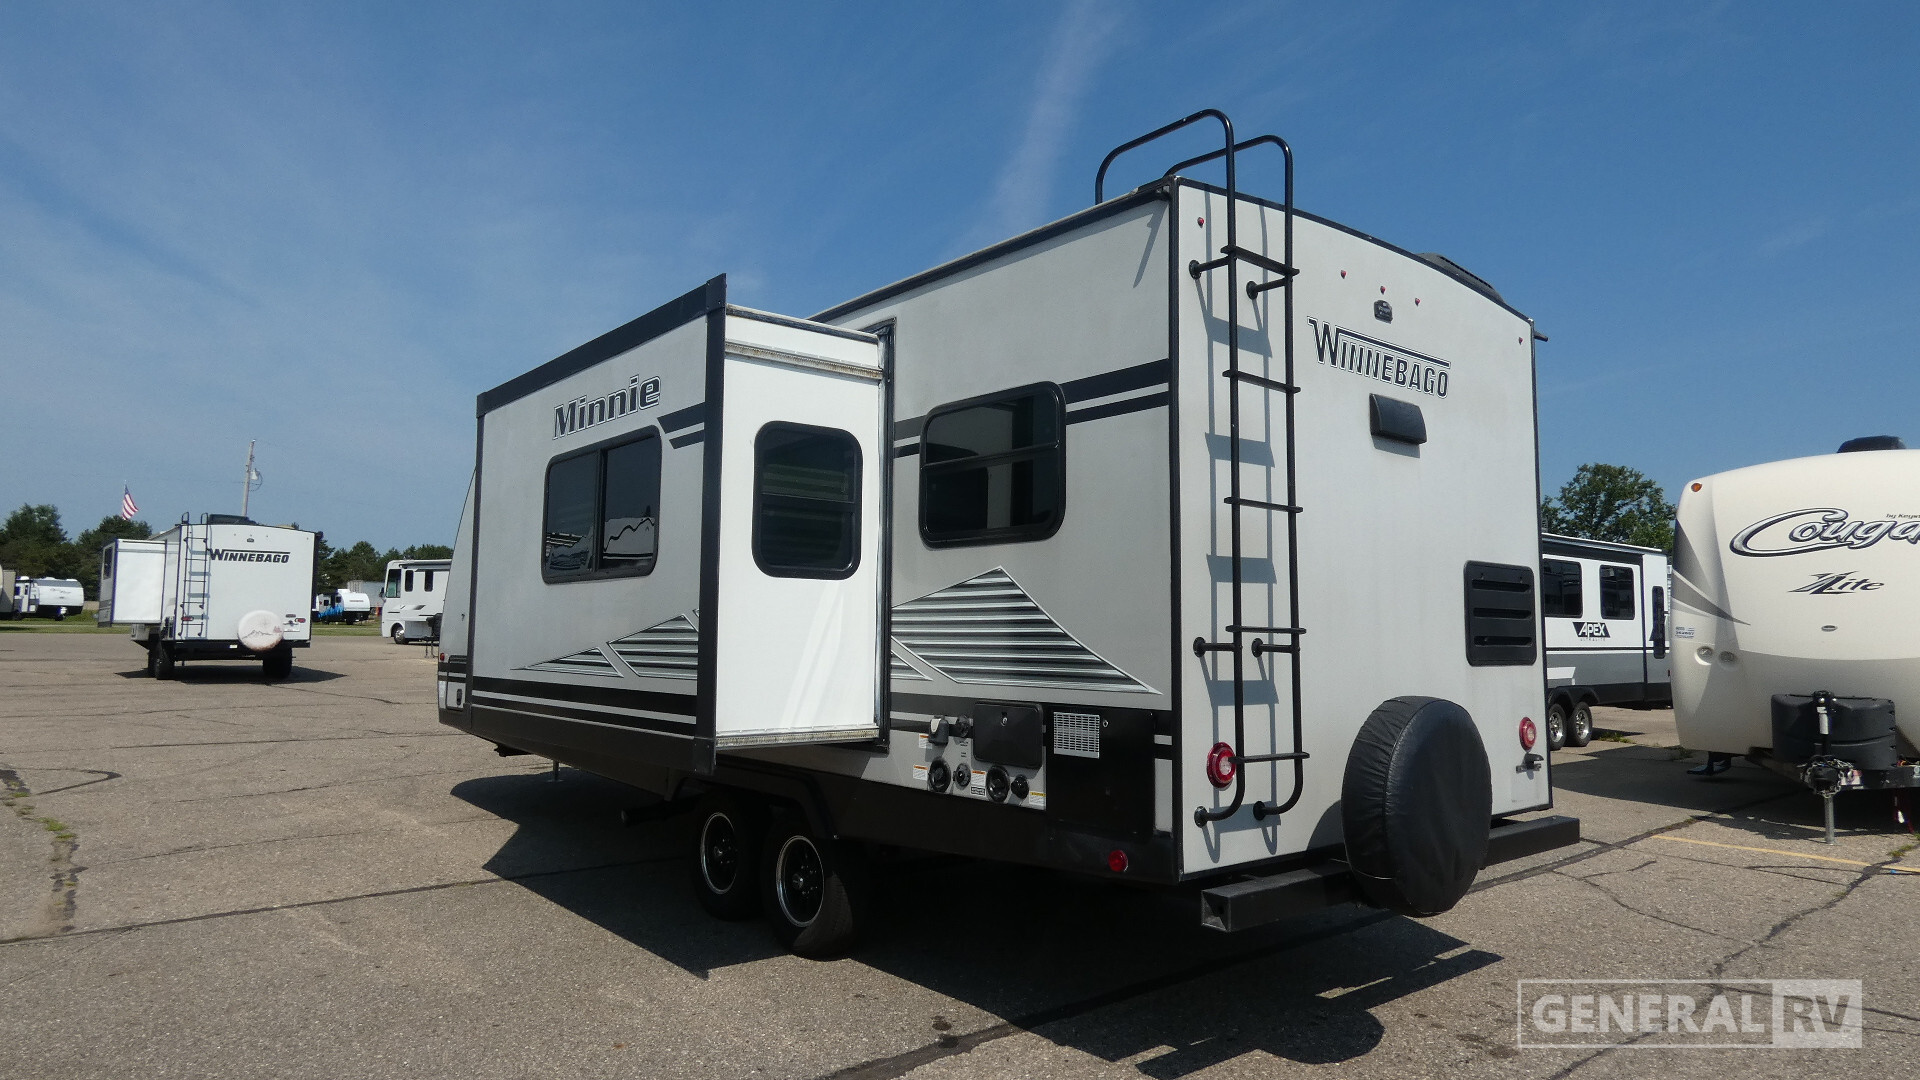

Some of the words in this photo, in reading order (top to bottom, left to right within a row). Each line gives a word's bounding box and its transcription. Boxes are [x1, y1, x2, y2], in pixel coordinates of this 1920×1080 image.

[1307, 316, 1451, 399] WINNEBAGO
[553, 374, 661, 440] Minnie
[206, 548, 291, 563] WINNEBAGO
[1729, 507, 1920, 557] Couga
[1578, 622, 1606, 638] APEX
